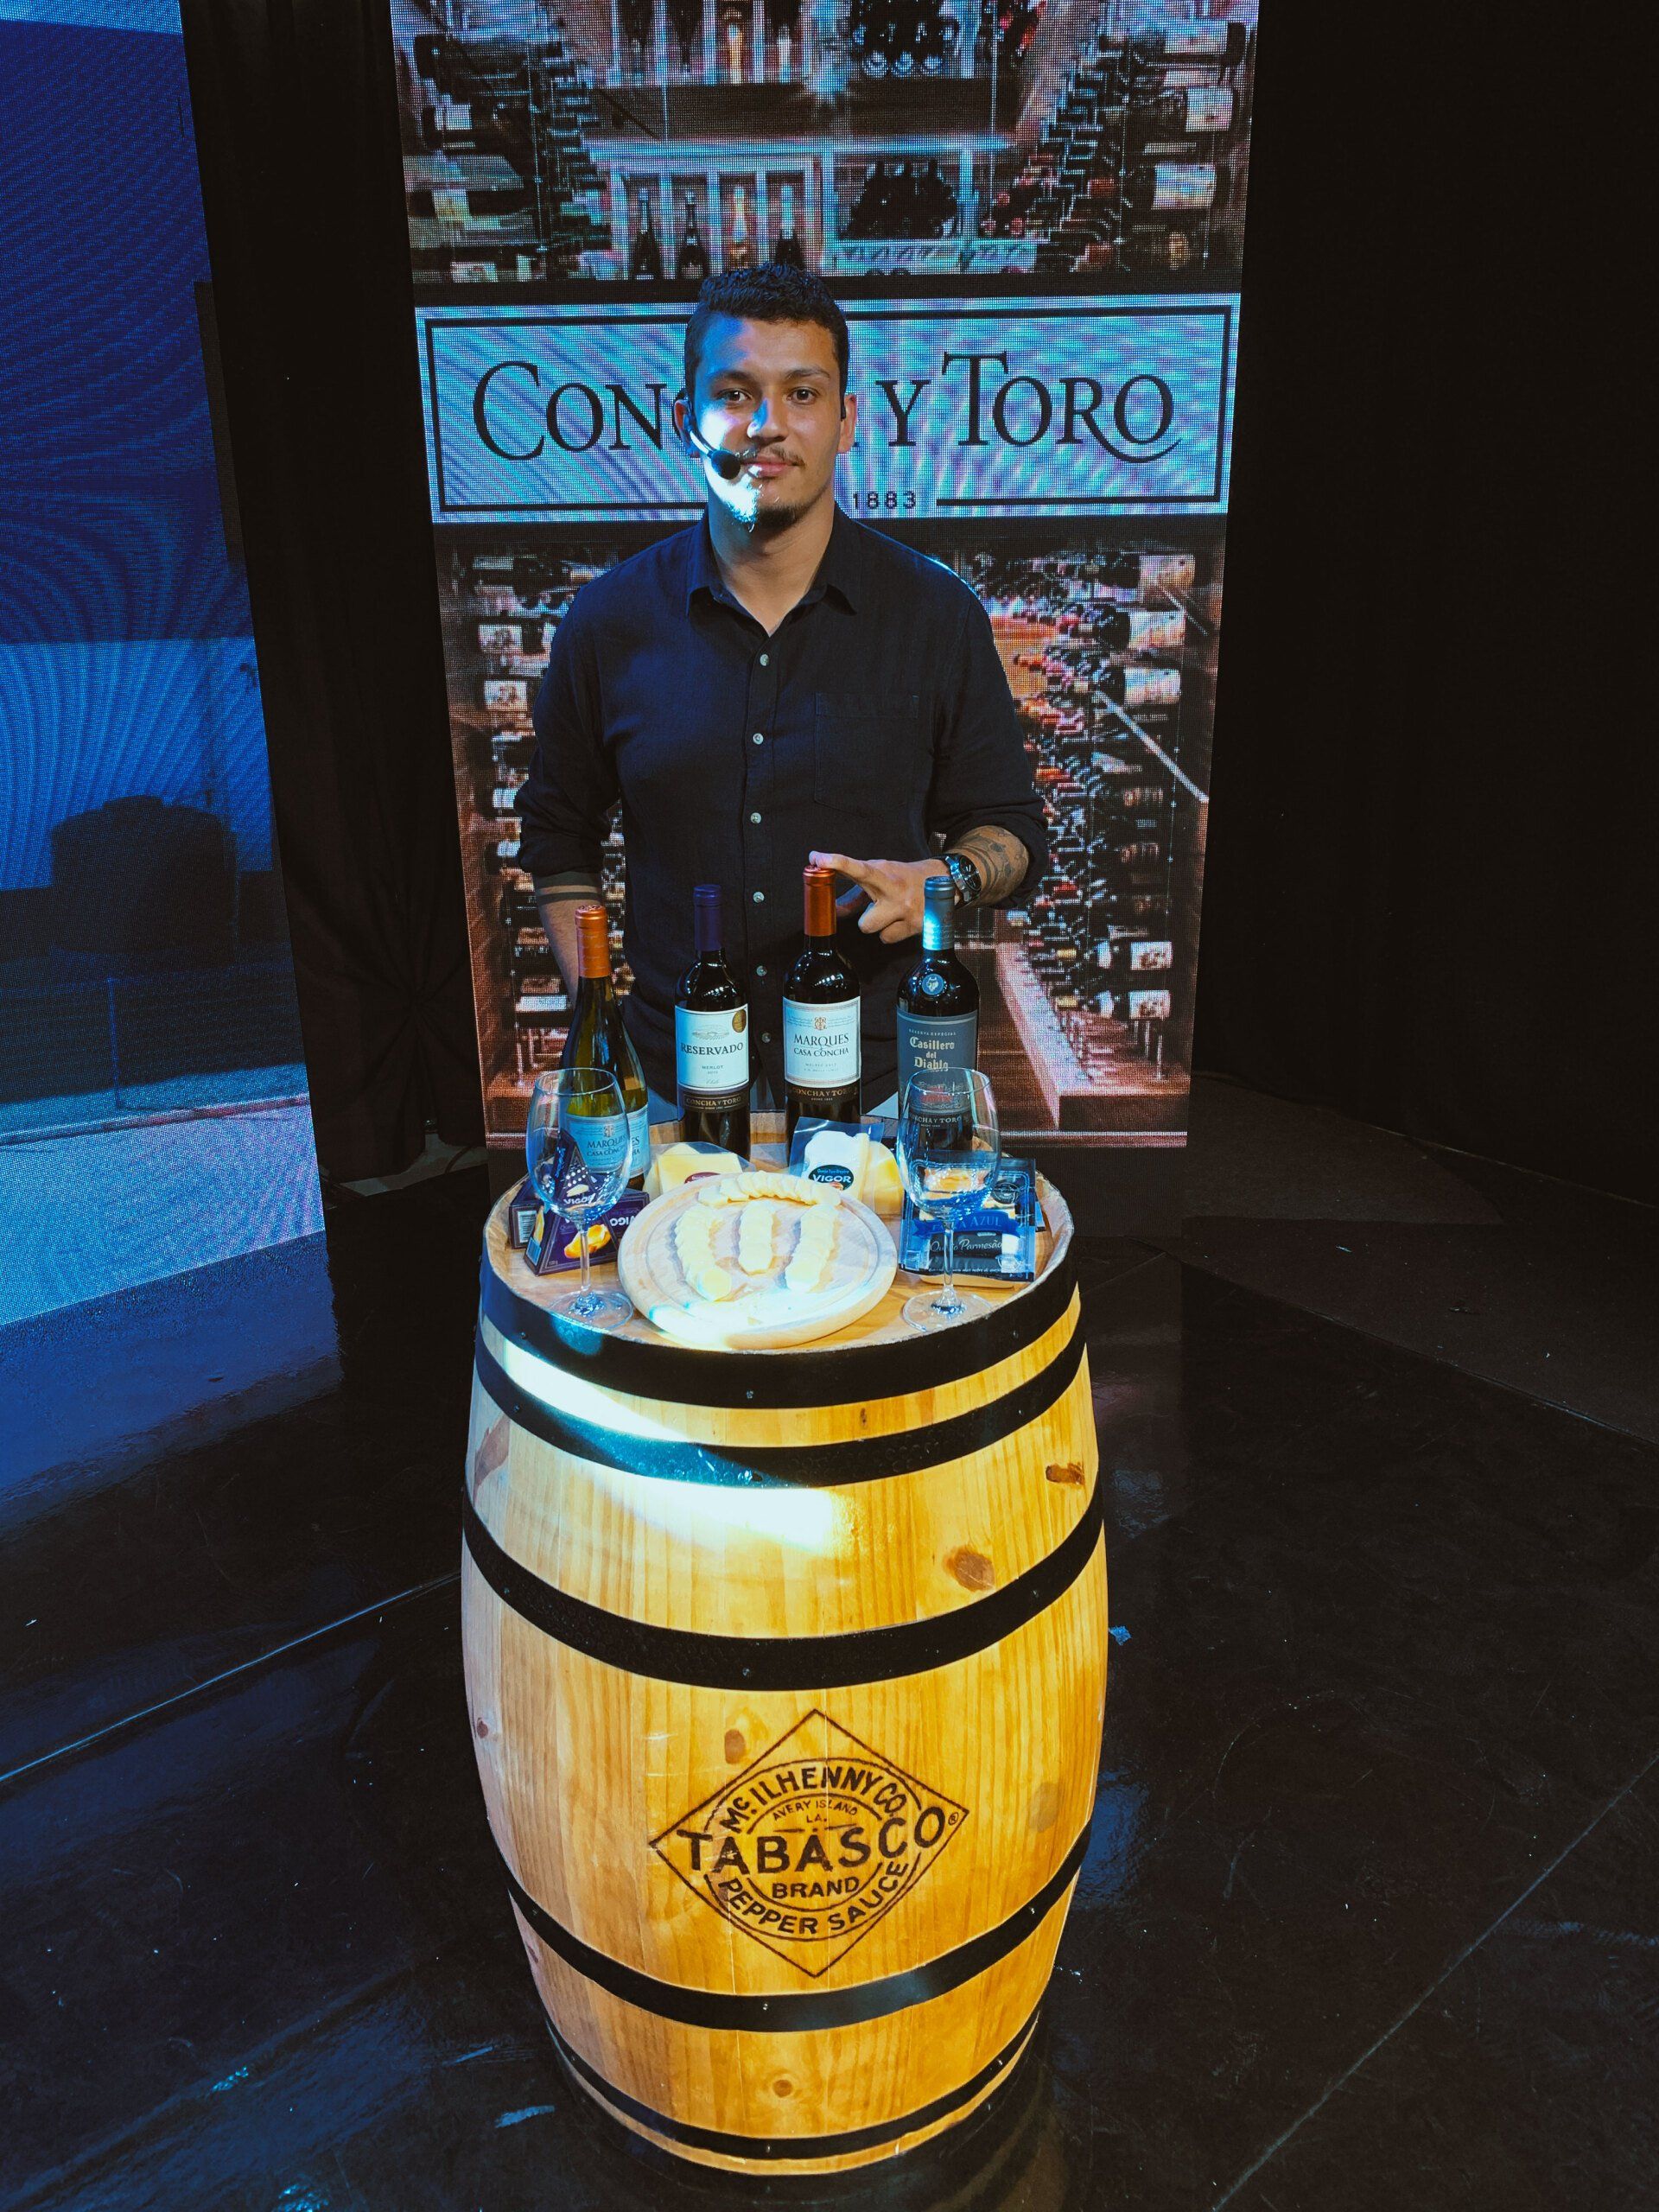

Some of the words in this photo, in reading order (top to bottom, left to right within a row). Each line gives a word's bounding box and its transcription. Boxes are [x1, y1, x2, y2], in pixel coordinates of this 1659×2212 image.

[875, 380, 931, 447] Y
[942, 352, 1181, 463] TORO
[853, 490, 916, 510] 1883
[793, 1033, 849, 1047] MARQUES
[909, 1036, 955, 1051] Casillero
[680, 1042, 744, 1055] RESERVADO
[793, 1047, 812, 1057] CASA
[813, 1048, 849, 1057] CONCHA
[925, 1051, 937, 1059] del
[812, 1174, 851, 1183] VIGOR
[970, 1216, 1001, 1227] AZUL
[772, 1800, 811, 1821] AVERY
[815, 1798, 859, 1817] ISLAND
[676, 1806, 946, 1876] TABASCO
[772, 1876, 860, 1899] BRAND
[718, 1878, 817, 1936] PEPPER
[827, 1861, 909, 1932] SAUCE
